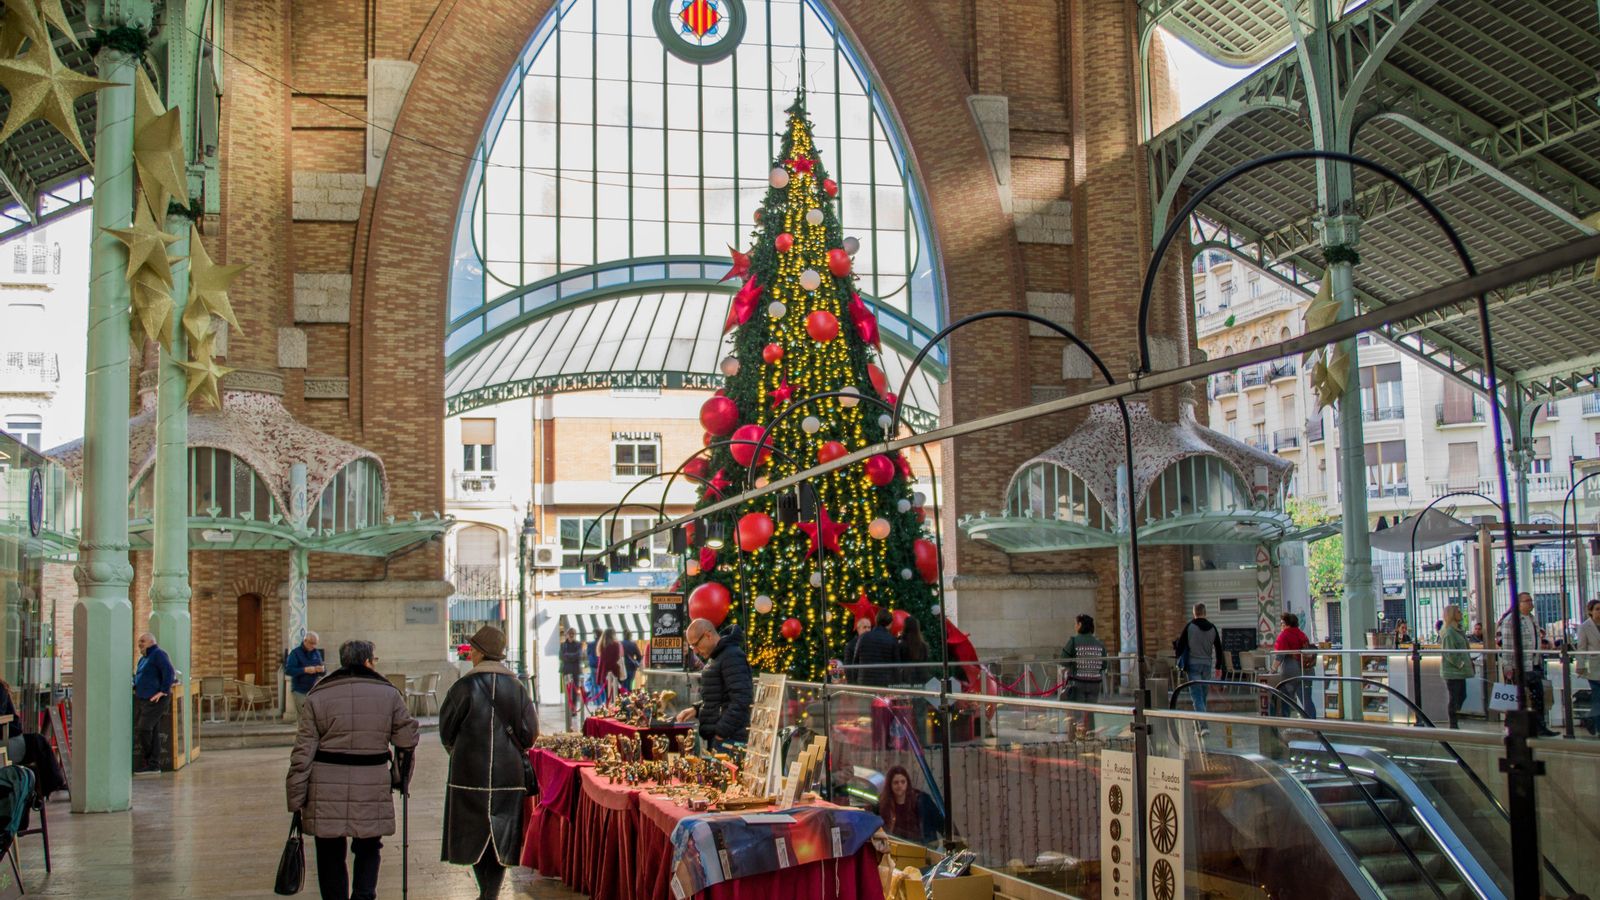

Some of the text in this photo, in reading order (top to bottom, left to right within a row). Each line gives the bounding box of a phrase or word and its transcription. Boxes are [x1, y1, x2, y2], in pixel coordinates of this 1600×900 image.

[654, 638, 681, 648] ABIERTO
[1114, 763, 1131, 775] Ruedas
[1161, 771, 1180, 784] Ruedas
